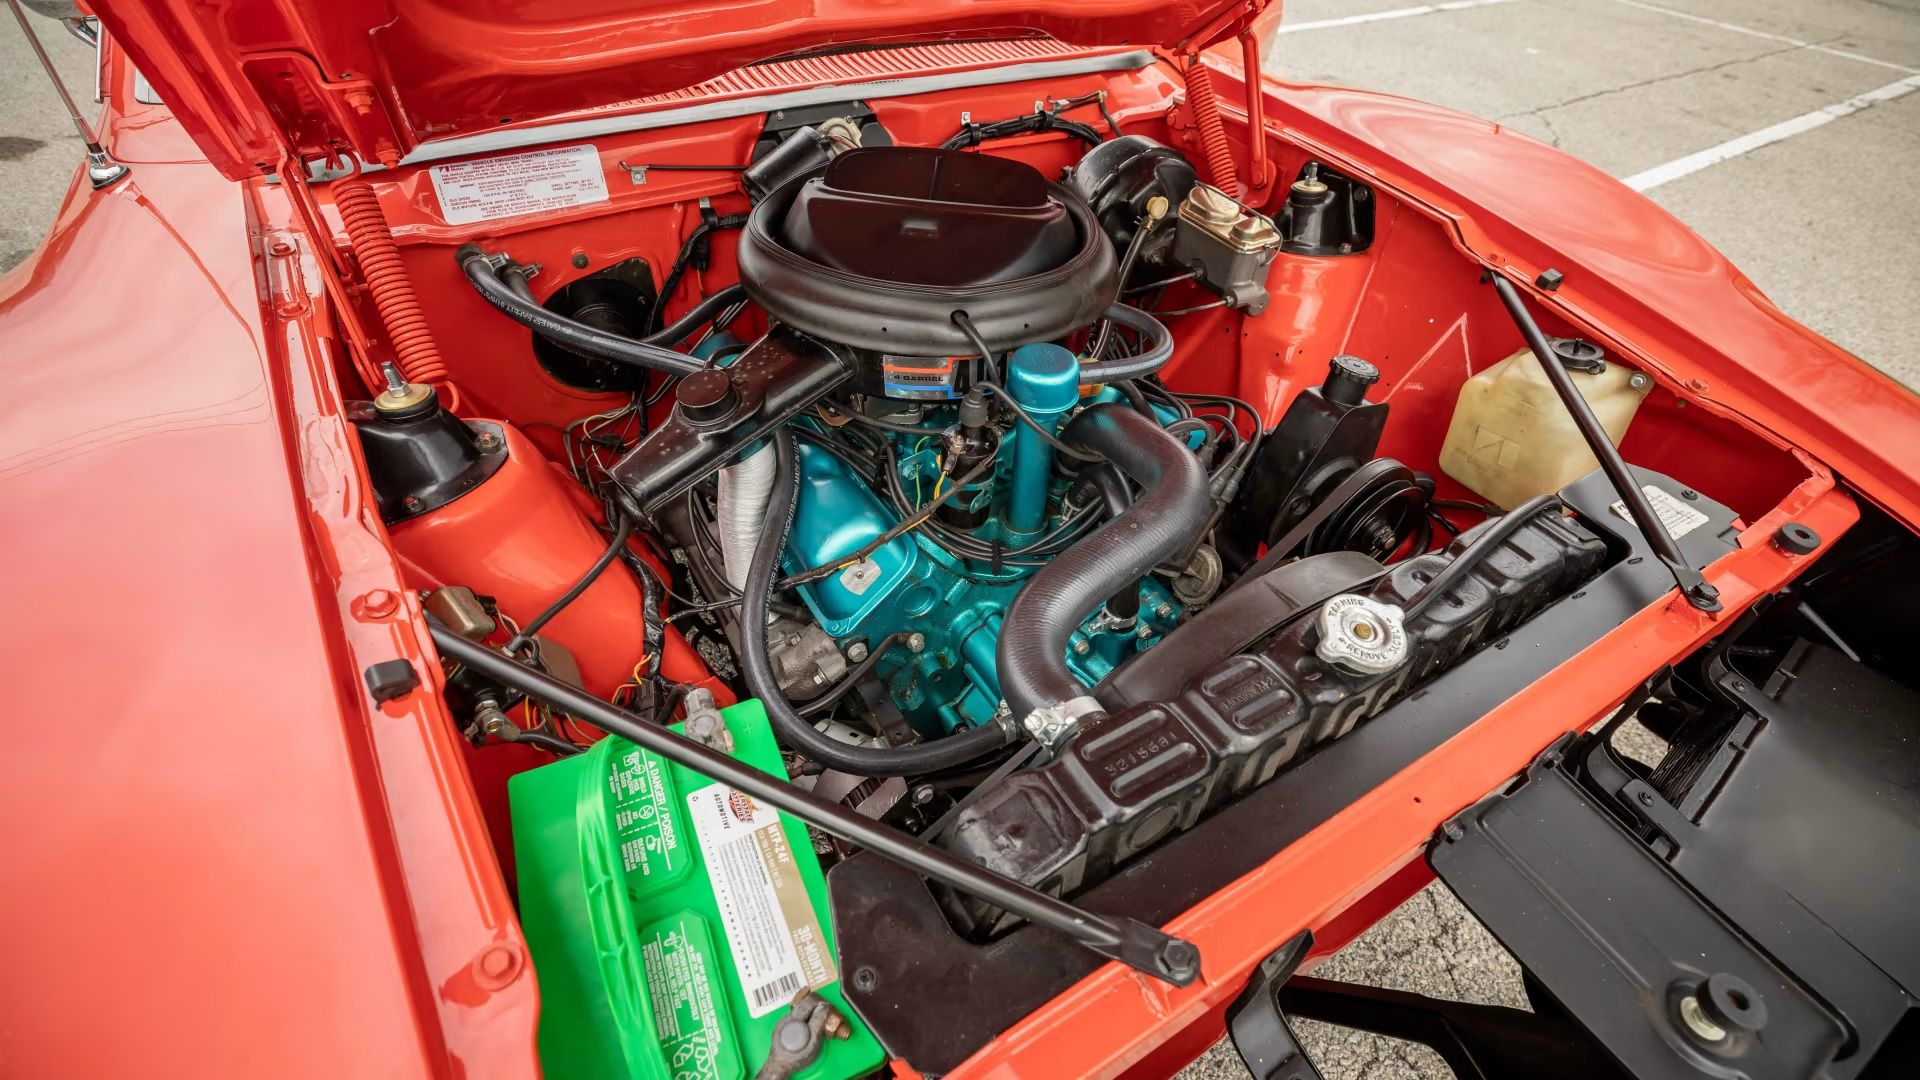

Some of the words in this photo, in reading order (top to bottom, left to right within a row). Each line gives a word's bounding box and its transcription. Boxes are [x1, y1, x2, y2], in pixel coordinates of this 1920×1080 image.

[506, 305, 533, 322] SAFETY
[767, 571, 776, 603] HEATER
[784, 515, 792, 536] INCH
[1328, 598, 1365, 618] WARNING
[1347, 644, 1389, 660] REMOVE
[649, 768, 666, 805] DANGER
[661, 813, 677, 849] POISON
[714, 794, 730, 829] AUTOMOTIVE
[748, 834, 759, 860] PROPOSITION
[758, 865, 768, 885] WARNING
[766, 823, 790, 864] MTP-24F
[799, 925, 827, 983] 30-MONTH
